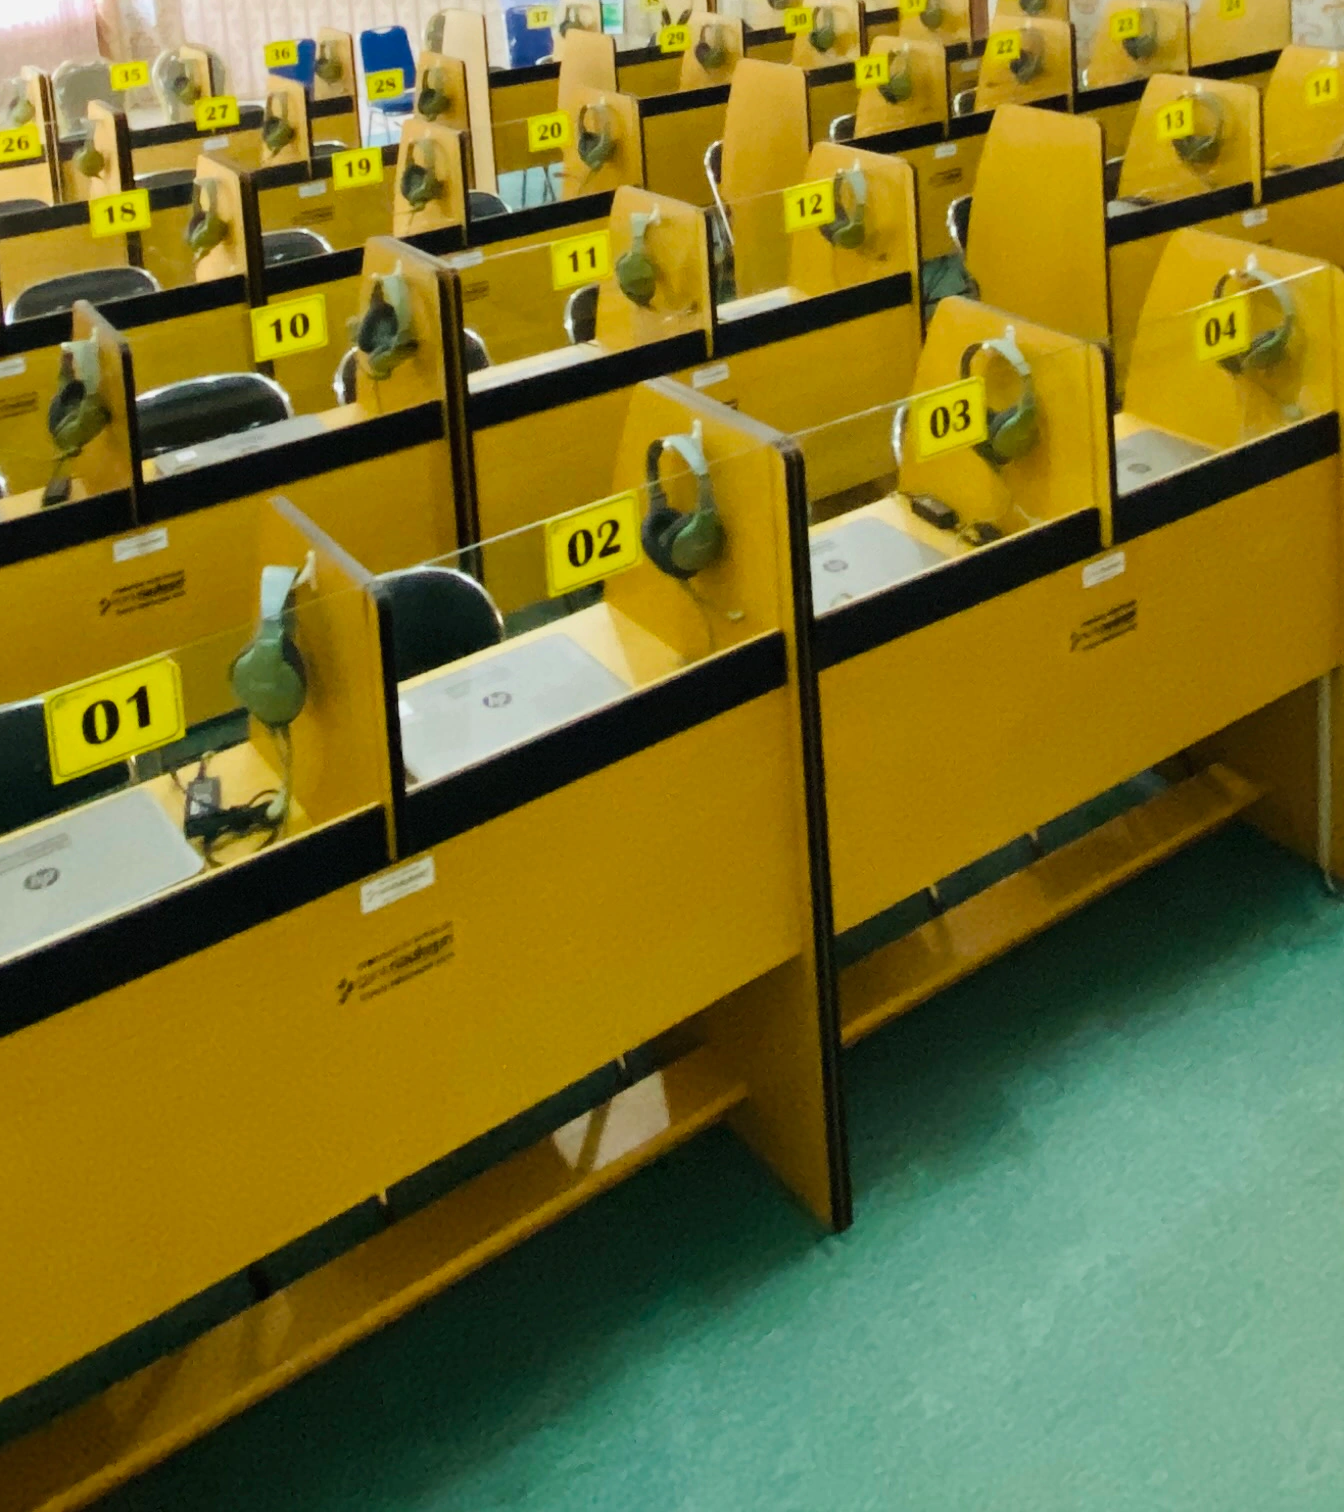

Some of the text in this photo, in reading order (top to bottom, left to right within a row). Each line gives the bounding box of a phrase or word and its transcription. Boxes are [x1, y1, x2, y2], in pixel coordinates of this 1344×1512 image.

[532, 11, 548, 23] 37
[792, 12, 807, 26] 30
[1118, 18, 1133, 32] 23
[668, 32, 684, 45] 29
[997, 40, 1013, 54] 22
[271, 47, 290, 61] 36
[119, 68, 141, 83] 35
[865, 64, 880, 79] 21
[376, 79, 396, 93] 28
[1314, 79, 1330, 96] 14
[207, 105, 228, 121] 27
[1166, 110, 1184, 130] 13
[539, 122, 561, 141] 20
[4, 137, 29, 152] 26
[346, 159, 370, 177] 19
[103, 202, 137, 224] 18
[798, 194, 822, 217] 12
[569, 247, 596, 272] 11
[272, 314, 309, 342] 10
[1205, 312, 1236, 346] 04
[930, 400, 970, 438] 03
[568, 520, 620, 567] 02
[82, 686, 150, 744] 01
